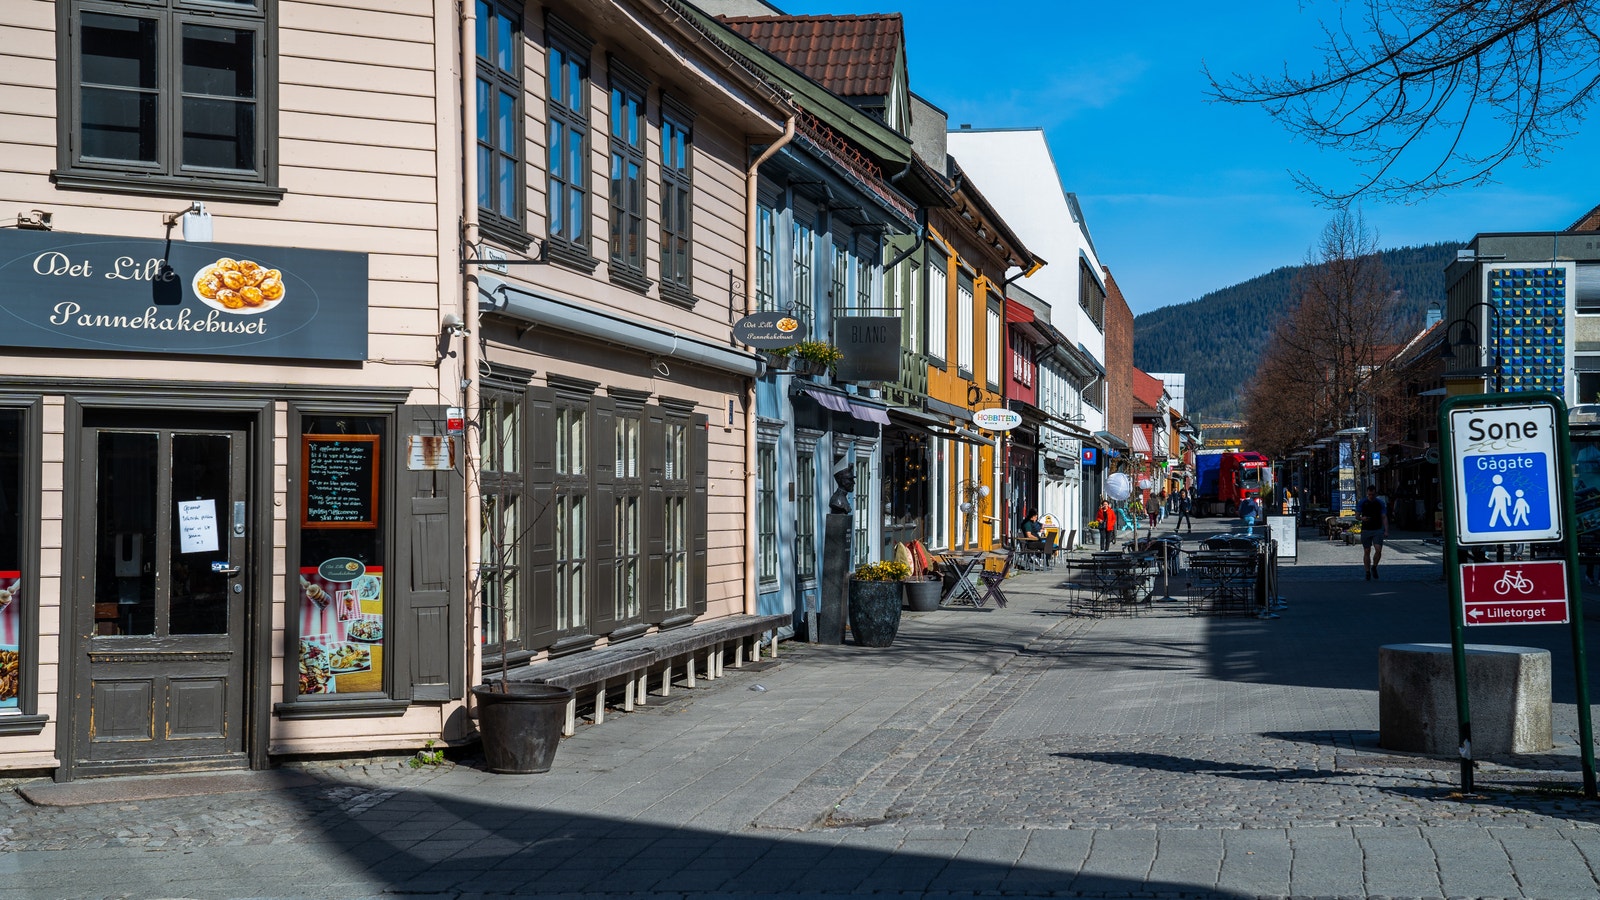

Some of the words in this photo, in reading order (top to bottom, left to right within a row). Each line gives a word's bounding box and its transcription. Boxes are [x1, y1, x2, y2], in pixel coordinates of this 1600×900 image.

[32, 250, 93, 278] Det
[104, 256, 176, 283] Lille
[49, 301, 268, 335] Pannekakehuset
[758, 321, 774, 329] Lille
[851, 325, 887, 344] BLANC
[977, 413, 1018, 422] HOBBITEN
[1468, 417, 1538, 442] Sone
[1476, 456, 1534, 473] Gågate
[1486, 607, 1547, 620] Lilletorget
